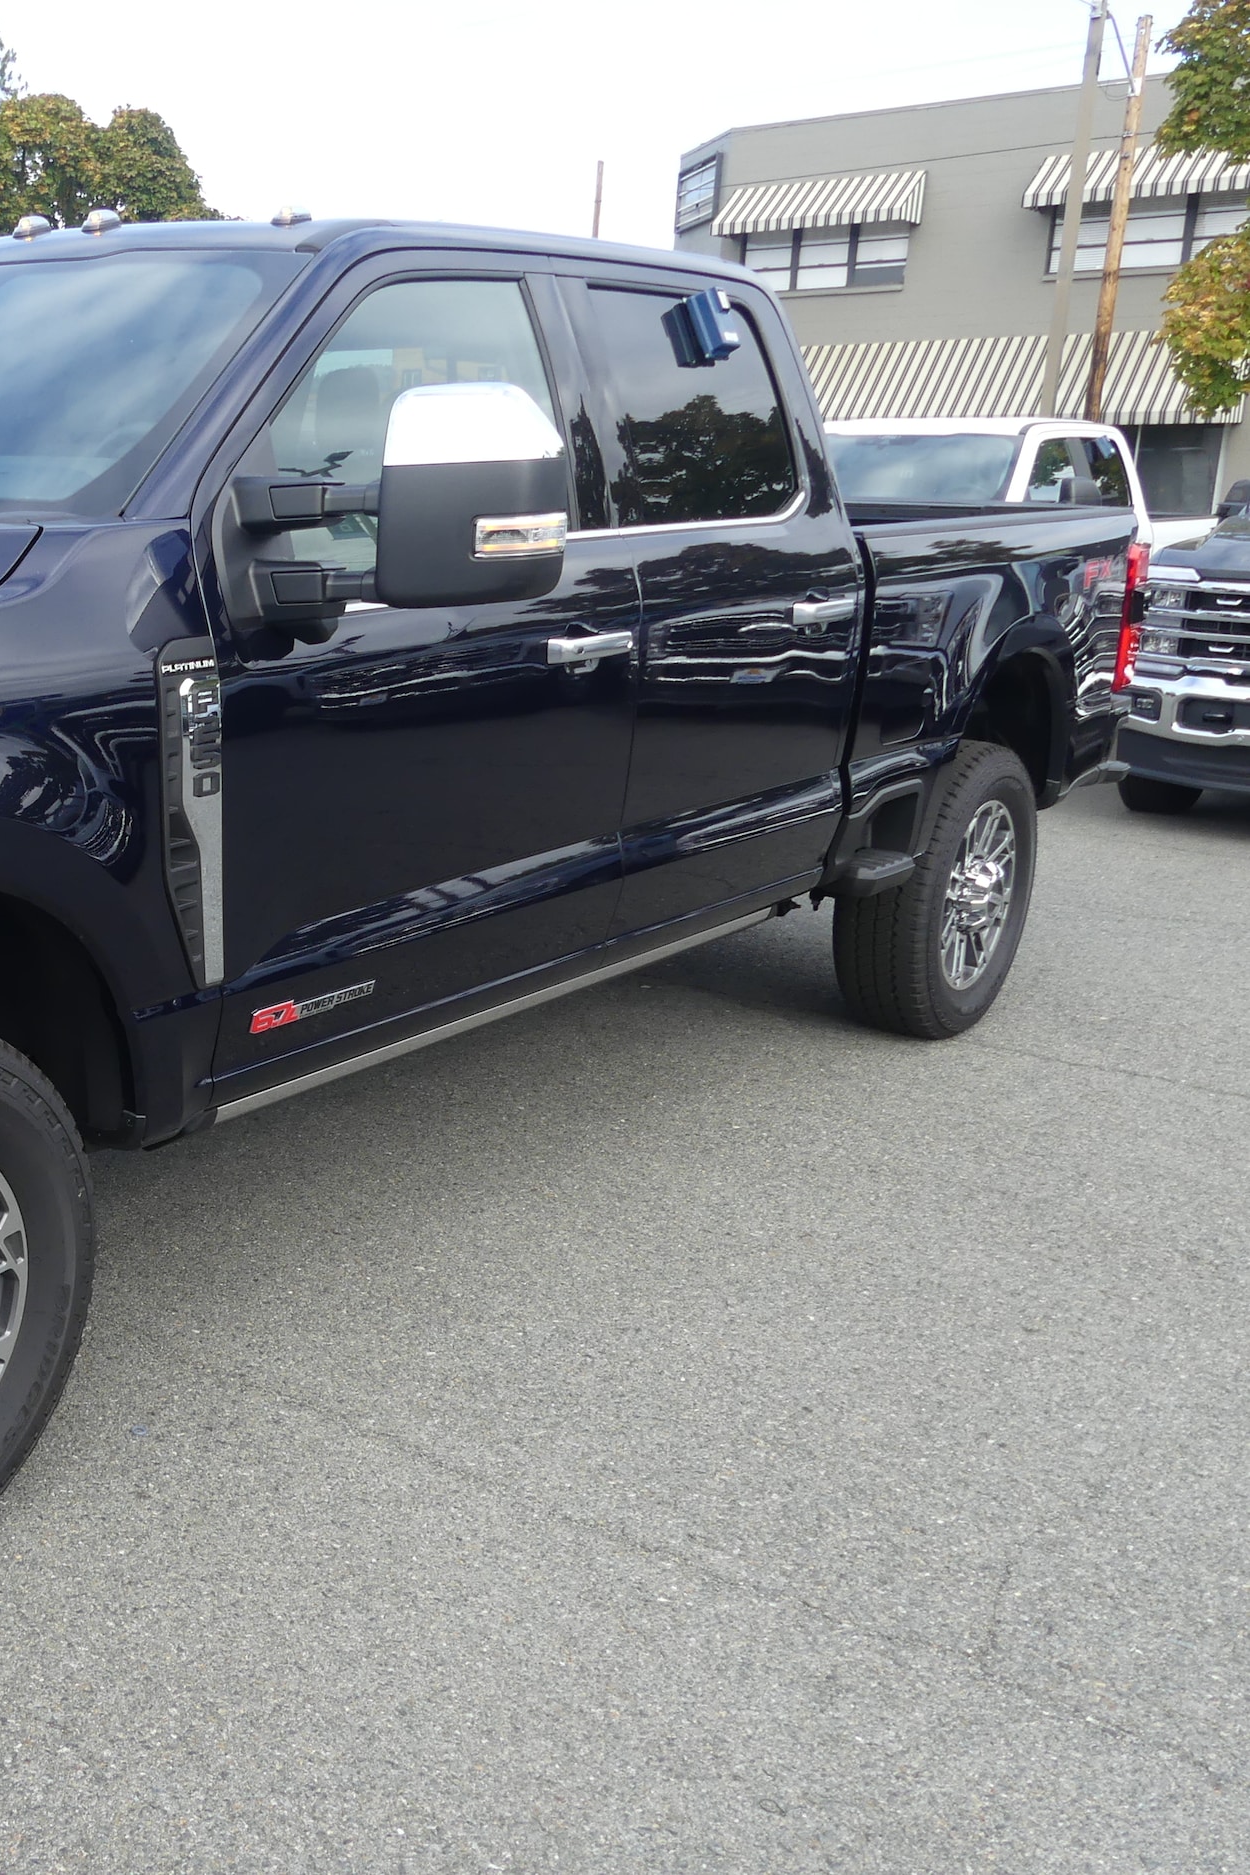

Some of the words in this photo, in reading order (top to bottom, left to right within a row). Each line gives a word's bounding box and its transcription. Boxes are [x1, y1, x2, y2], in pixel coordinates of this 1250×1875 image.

[1083, 555, 1126, 590] FX4
[161, 659, 215, 674] PLATINUM
[300, 995, 335, 1015] POWER
[334, 983, 374, 1004] STROKE
